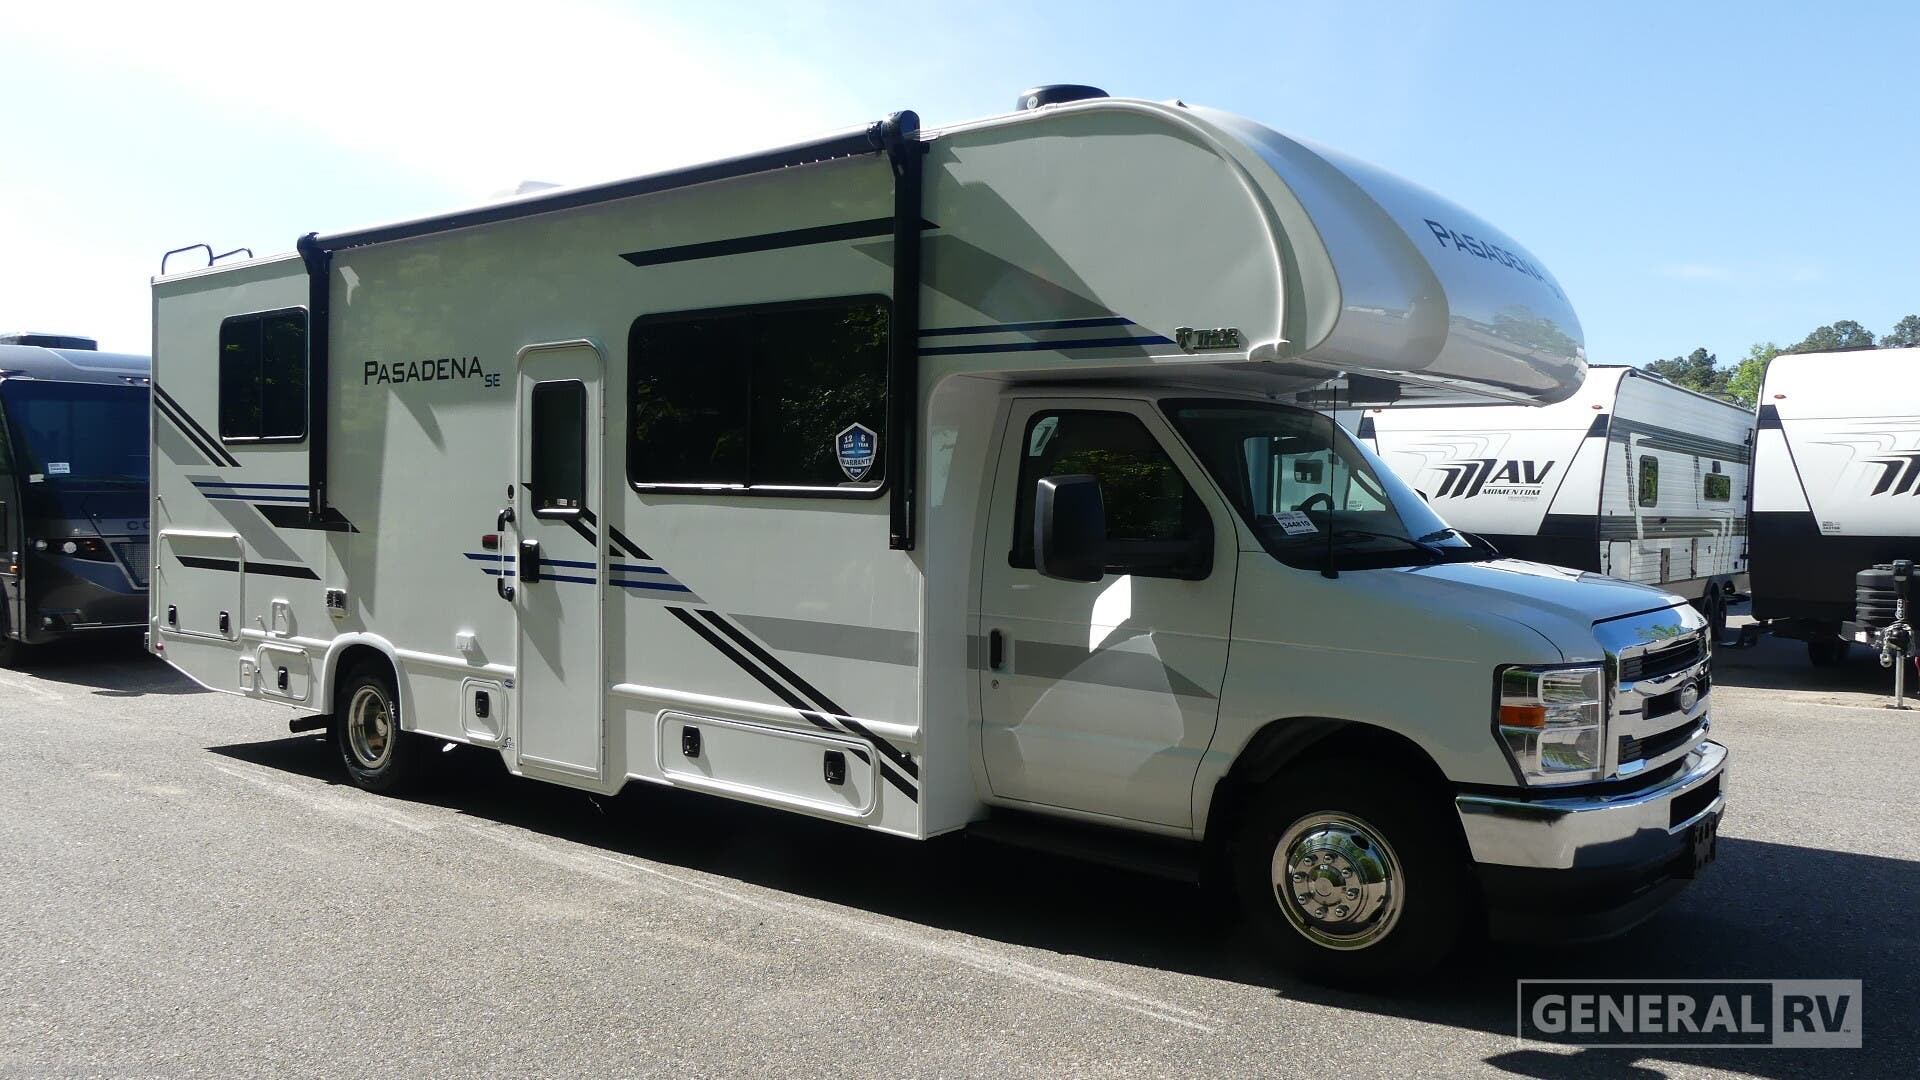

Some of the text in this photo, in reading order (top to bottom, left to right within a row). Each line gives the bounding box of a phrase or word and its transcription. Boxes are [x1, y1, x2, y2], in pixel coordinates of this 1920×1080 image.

[1193, 327, 1240, 350] THOR
[364, 356, 501, 387] PASADENA SE
[844, 434, 866, 444] 12 6
[1482, 488, 1541, 496] MOMENTUM
